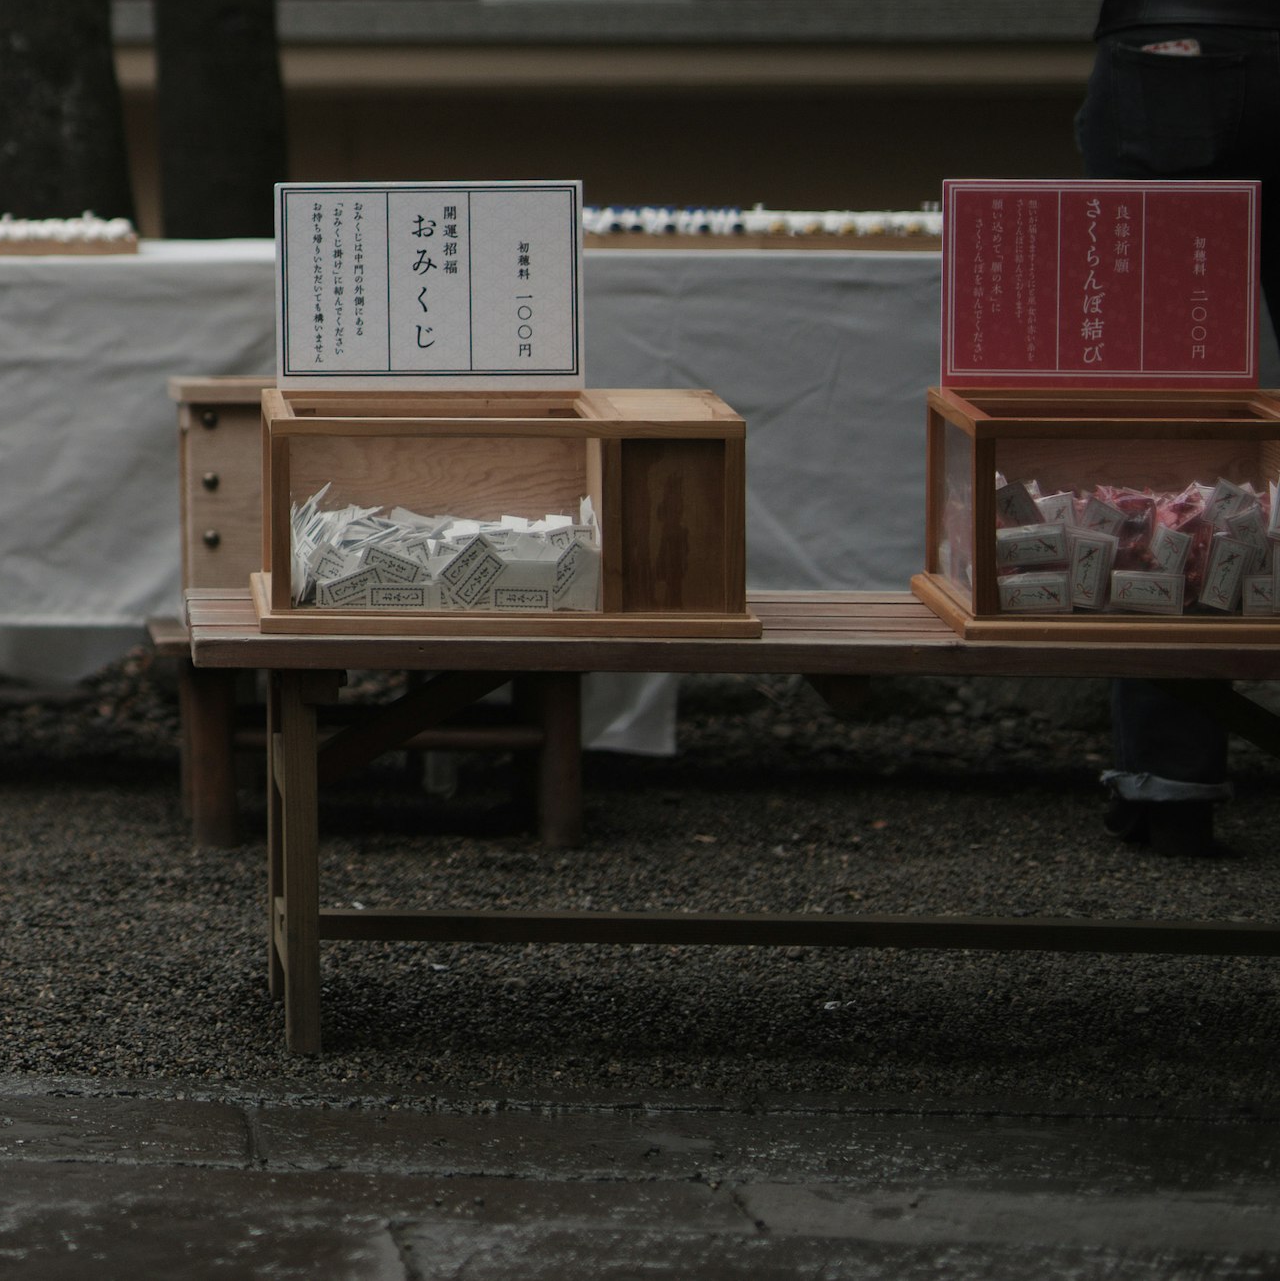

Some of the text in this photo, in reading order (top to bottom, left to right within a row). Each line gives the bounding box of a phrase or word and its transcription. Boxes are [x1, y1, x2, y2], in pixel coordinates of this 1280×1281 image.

[312, 202, 325, 363] お持ち帰りいただいても構いません
[332, 202, 345, 356] 「おみくじ掛け」に結んでください
[353, 202, 365, 337] おみくじは中門の外側にある
[411, 214, 438, 350] おみくじ
[443, 206, 458, 275] 開運招福
[516, 241, 534, 358] 初穂料 一〇〇円
[972, 219, 985, 363] さくらんぼを結んでください
[1080, 198, 1105, 364] さくらんぼ結び
[1113, 205, 1131, 274] 良縁祈願
[1190, 236, 1208, 359] 初穂料 二〇〇円
[381, 589, 420, 602] おみくじ
[506, 593, 544, 602] おみくじ
